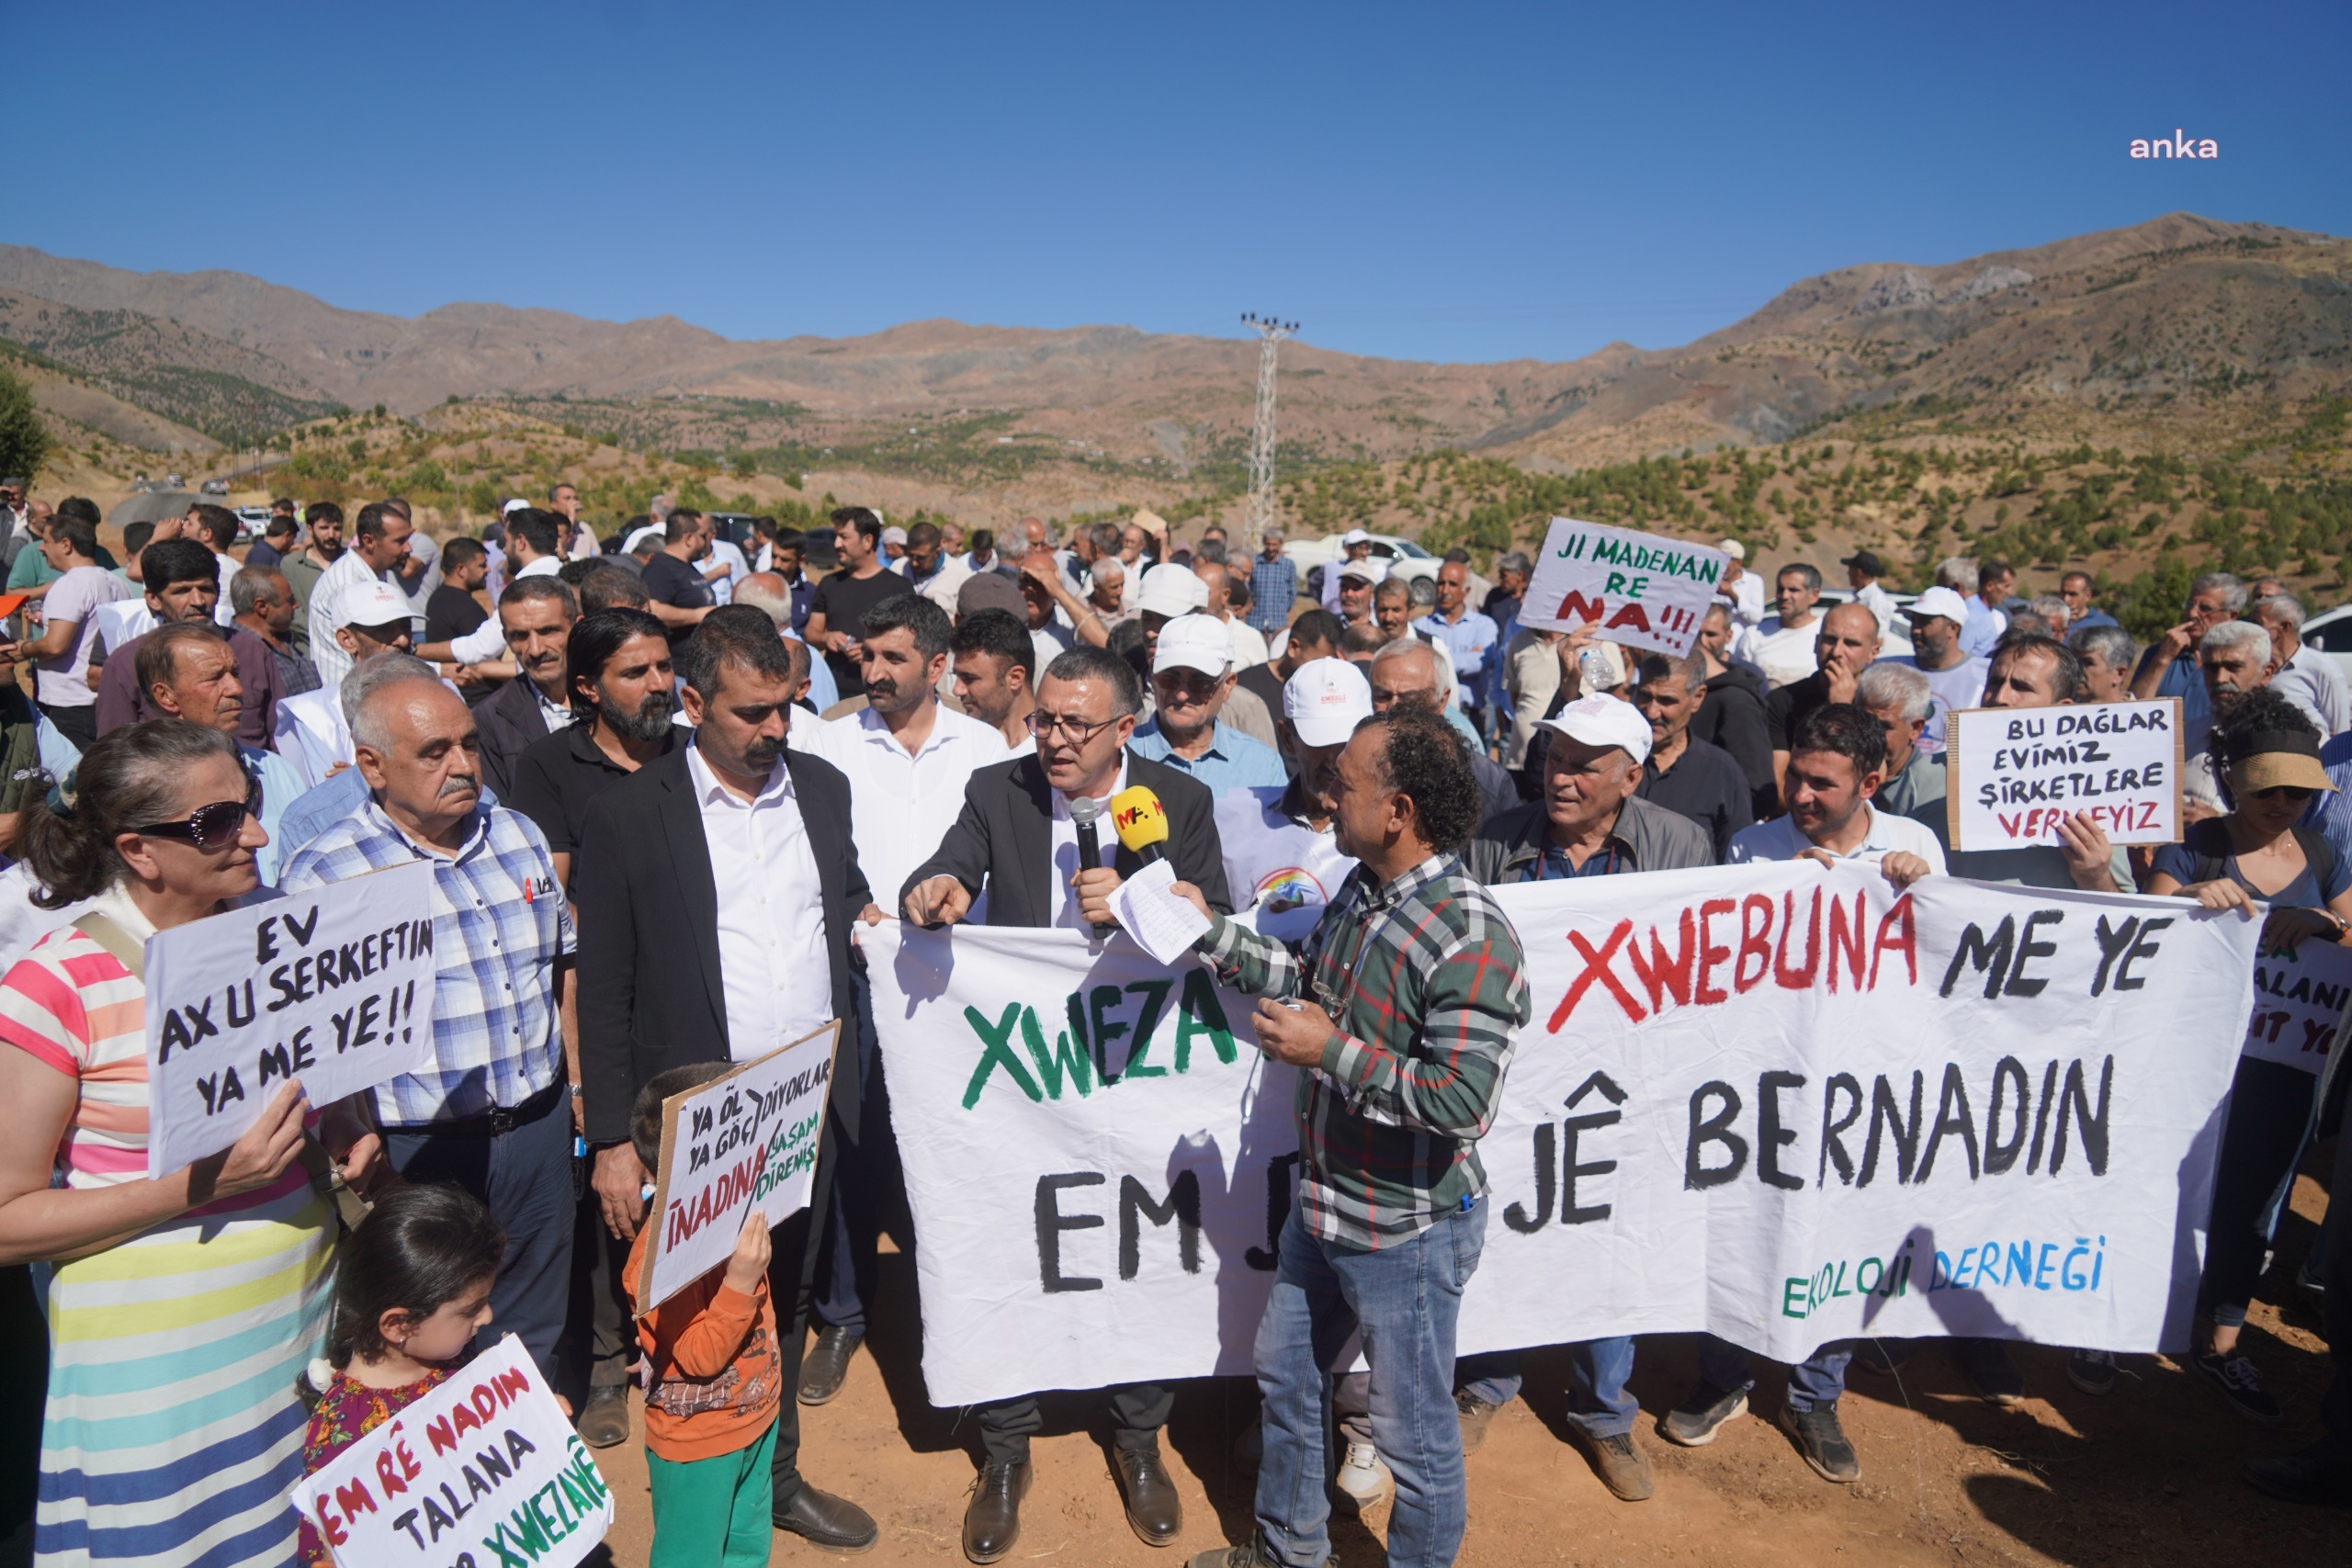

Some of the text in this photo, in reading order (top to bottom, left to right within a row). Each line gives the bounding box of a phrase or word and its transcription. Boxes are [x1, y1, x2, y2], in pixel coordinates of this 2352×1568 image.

[1557, 534, 1719, 585] JI MADENAN
[1604, 571, 1649, 598] RE
[2007, 707, 2168, 740] BU DAĞLAR
[1993, 739, 2110, 771] EVİMİZ
[1977, 761, 2164, 810] ŞİRKETLERE
[1997, 797, 2162, 839] VEREYİZ
[256, 905, 319, 964] EV
[158, 919, 433, 1065] AX U SERKEFTIN
[961, 884, 2175, 1111] XWEZA XWEBUNA ME YE
[196, 979, 414, 1116] YA ME YE!!
[692, 1085, 743, 1142] YA ÖL
[761, 1057, 831, 1122] DİYORLAR
[689, 1142, 709, 1175] YA
[1034, 1169, 1204, 1293] EM
[1503, 1069, 1628, 1236] JÊ
[1683, 1054, 2113, 1191] BERNADIN
[316, 1365, 530, 1547] EM RÊ NADIN
[393, 1428, 536, 1551] TALANA
[482, 1434, 608, 1568] XWEZAYÊ
